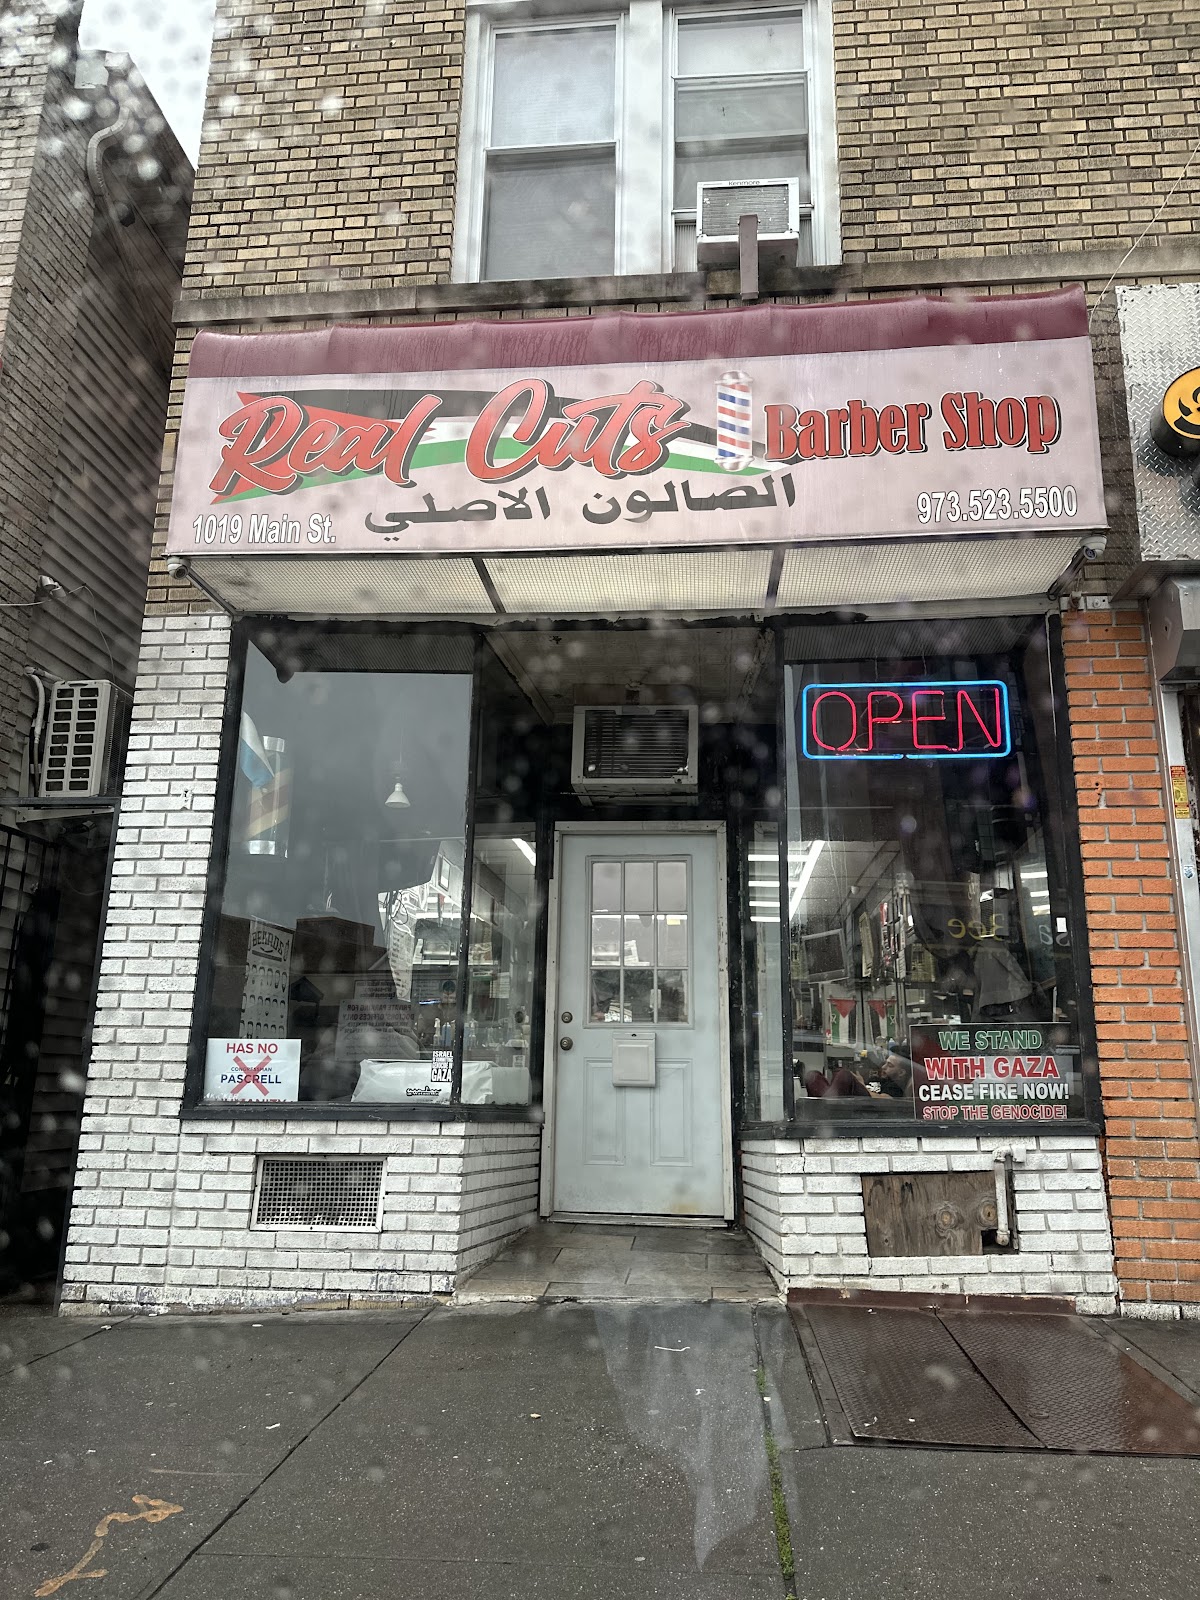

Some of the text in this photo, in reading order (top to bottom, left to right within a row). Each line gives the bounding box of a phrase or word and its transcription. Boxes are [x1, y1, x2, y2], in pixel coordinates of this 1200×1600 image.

[208, 377, 692, 491] Real Cuts
[764, 391, 1062, 462] Barber Shop
[582, 472, 796, 524] الصالون
[916, 485, 1077, 524] 973.523.5500
[192, 512, 336, 545] 1019 Main St.
[811, 688, 1002, 751] OPEN
[226, 1042, 278, 1054] HAS NO
[938, 1030, 1042, 1050] WE STAND
[432, 1050, 453, 1058] ISRAEL
[220, 1074, 281, 1084] PASCRELL
[431, 1068, 452, 1082] GAZA
[924, 1056, 1060, 1080] WITH GAZA
[918, 1083, 1069, 1101] CEASE FIRE NOW!
[922, 1105, 1067, 1120] STOP THE GENOCIDE!
